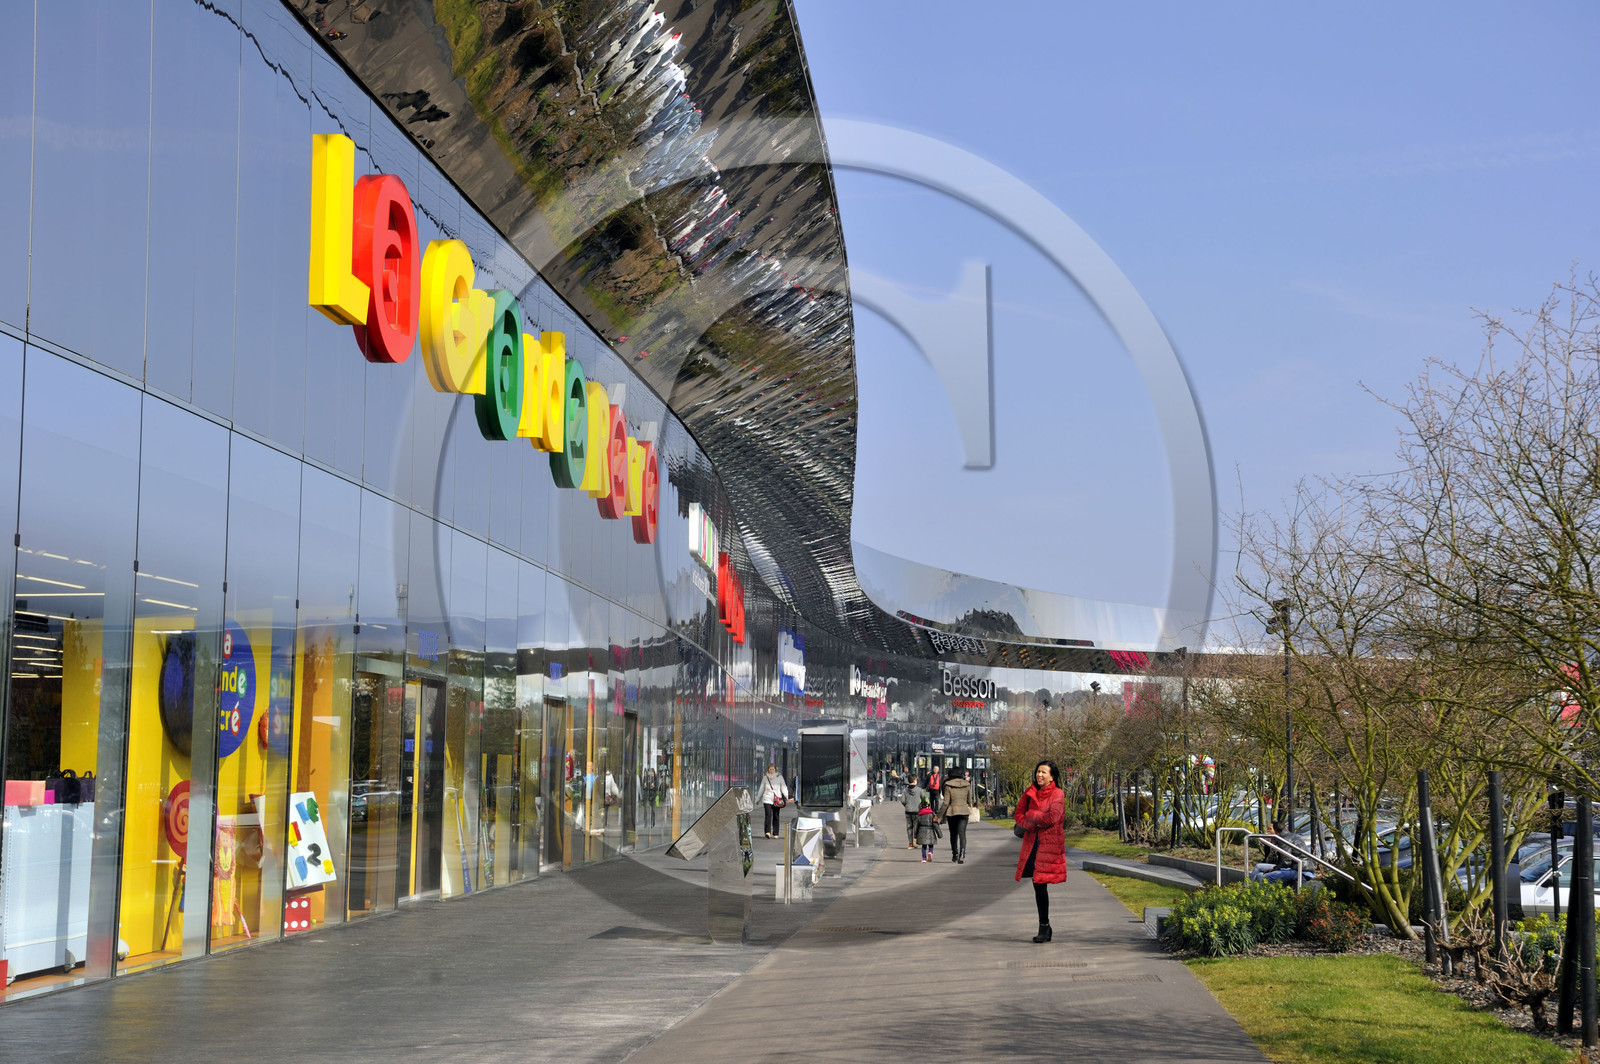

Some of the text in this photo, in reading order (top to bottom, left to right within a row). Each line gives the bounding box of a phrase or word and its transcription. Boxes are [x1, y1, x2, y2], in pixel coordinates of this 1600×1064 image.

[309, 134, 660, 544] La Grande Récré
[417, 629, 439, 662] SORTIE
[221, 666, 247, 697] nde
[943, 669, 997, 699] Besson
[219, 701, 241, 734] cré
[952, 698, 985, 709] chaussures
